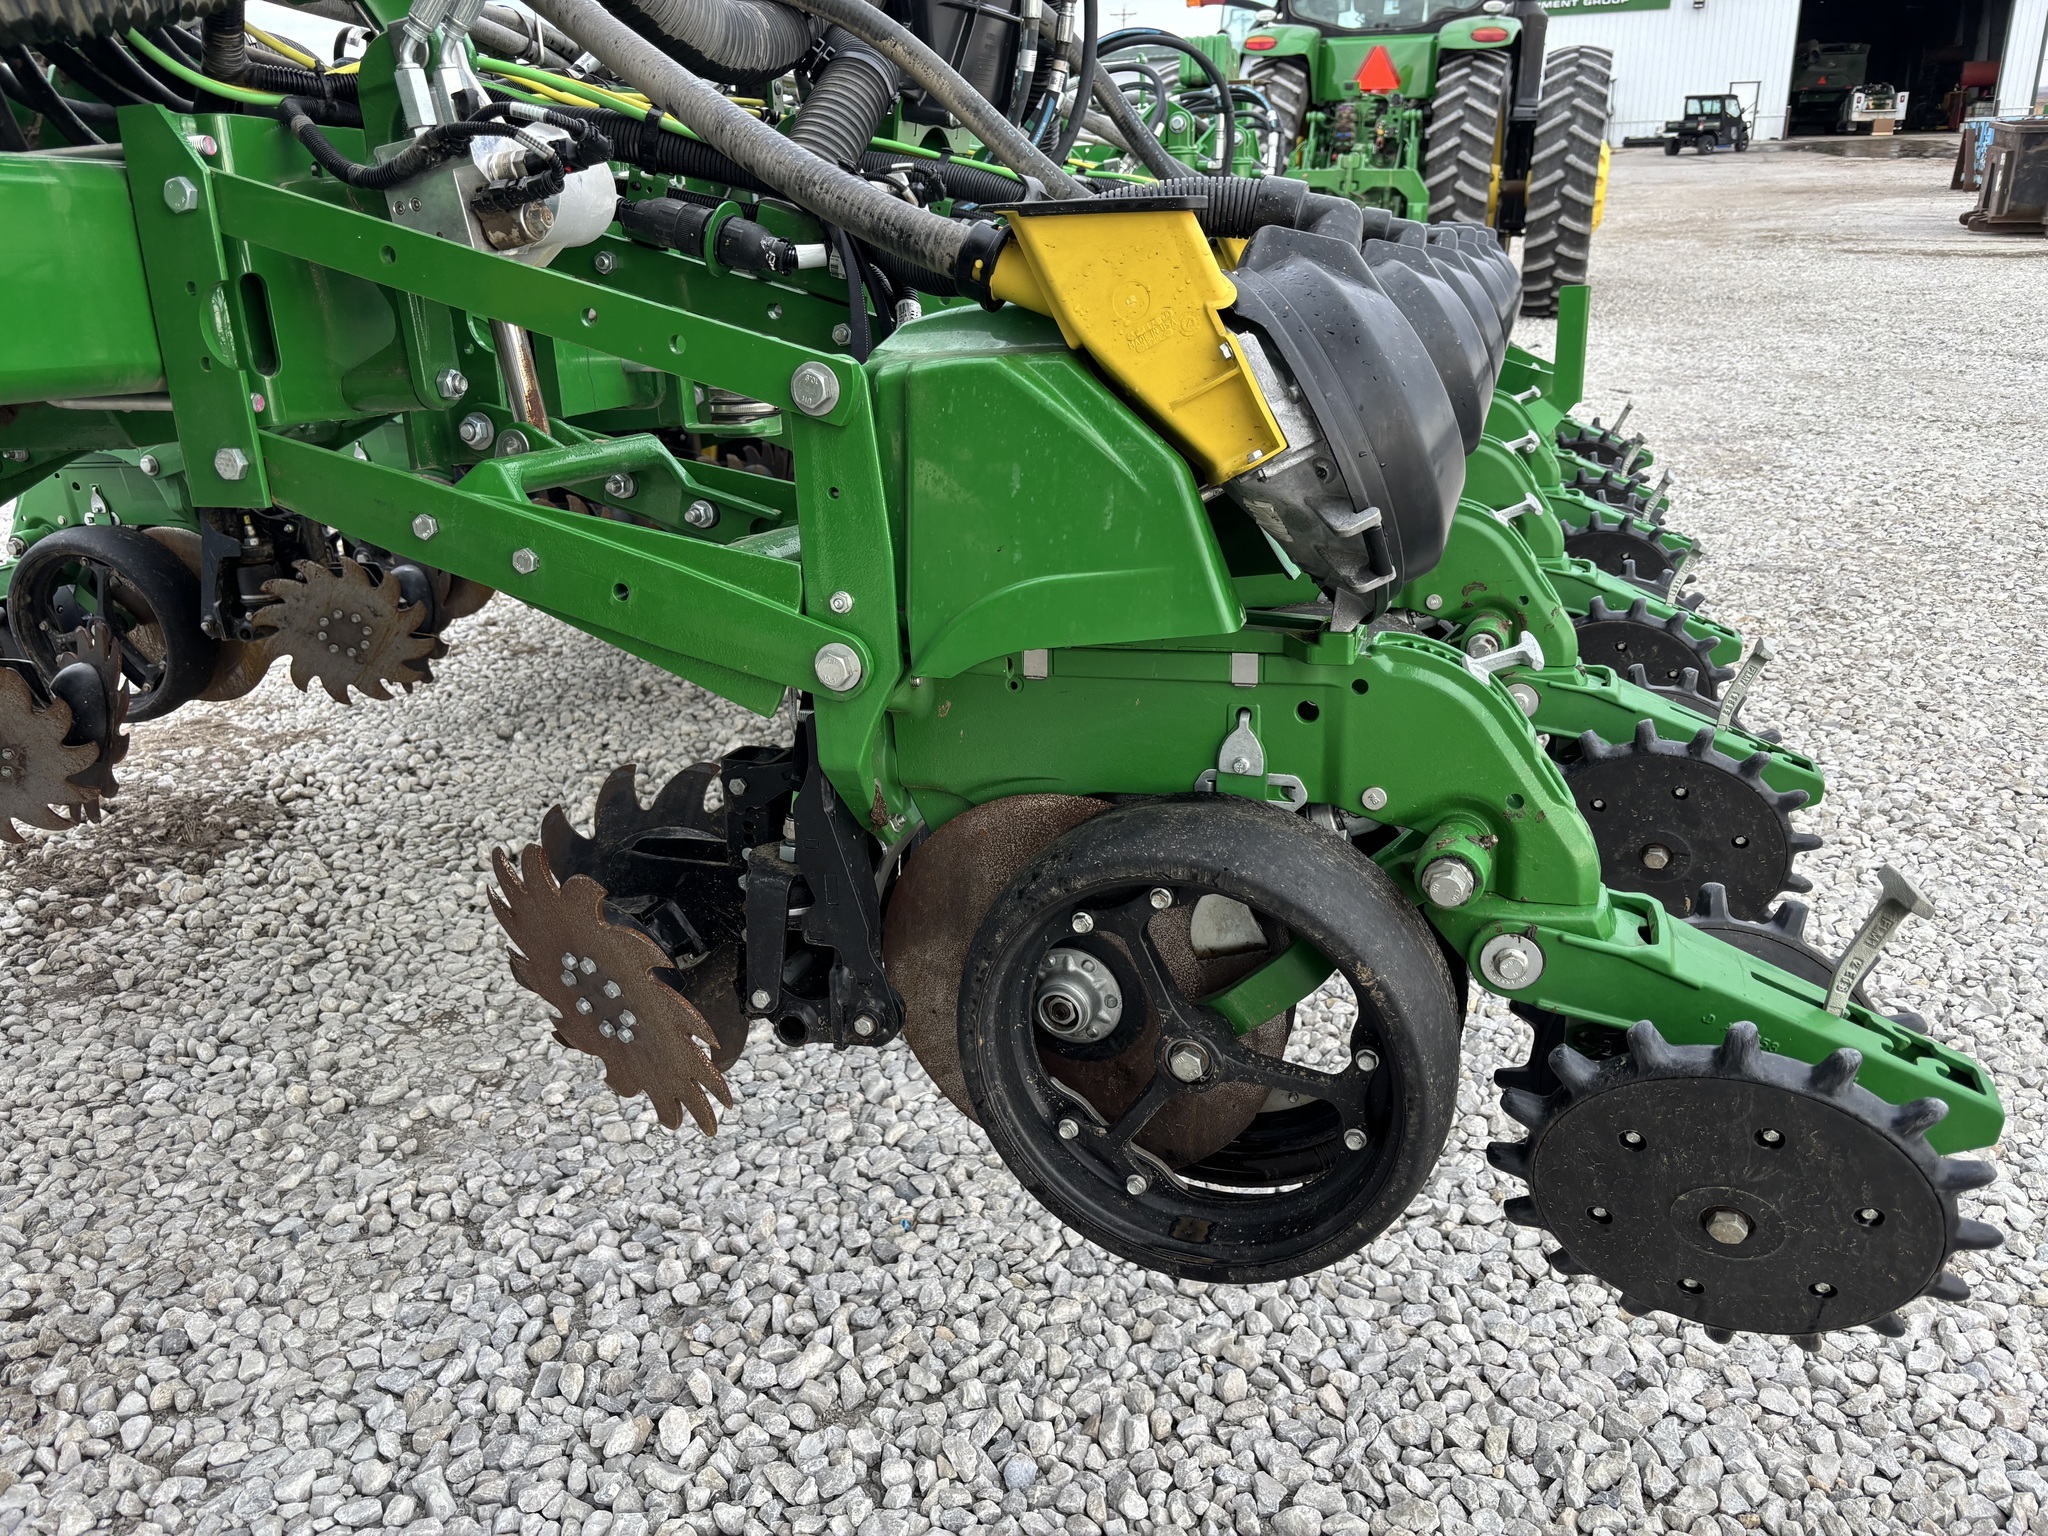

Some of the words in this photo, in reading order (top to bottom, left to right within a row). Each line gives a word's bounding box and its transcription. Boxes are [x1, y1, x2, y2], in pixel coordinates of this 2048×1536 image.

[1004, 124, 1016, 137] TO
[1020, 142, 1035, 157] RU
[1128, 334, 1151, 350] MADE
[1160, 318, 1178, 332] USA
